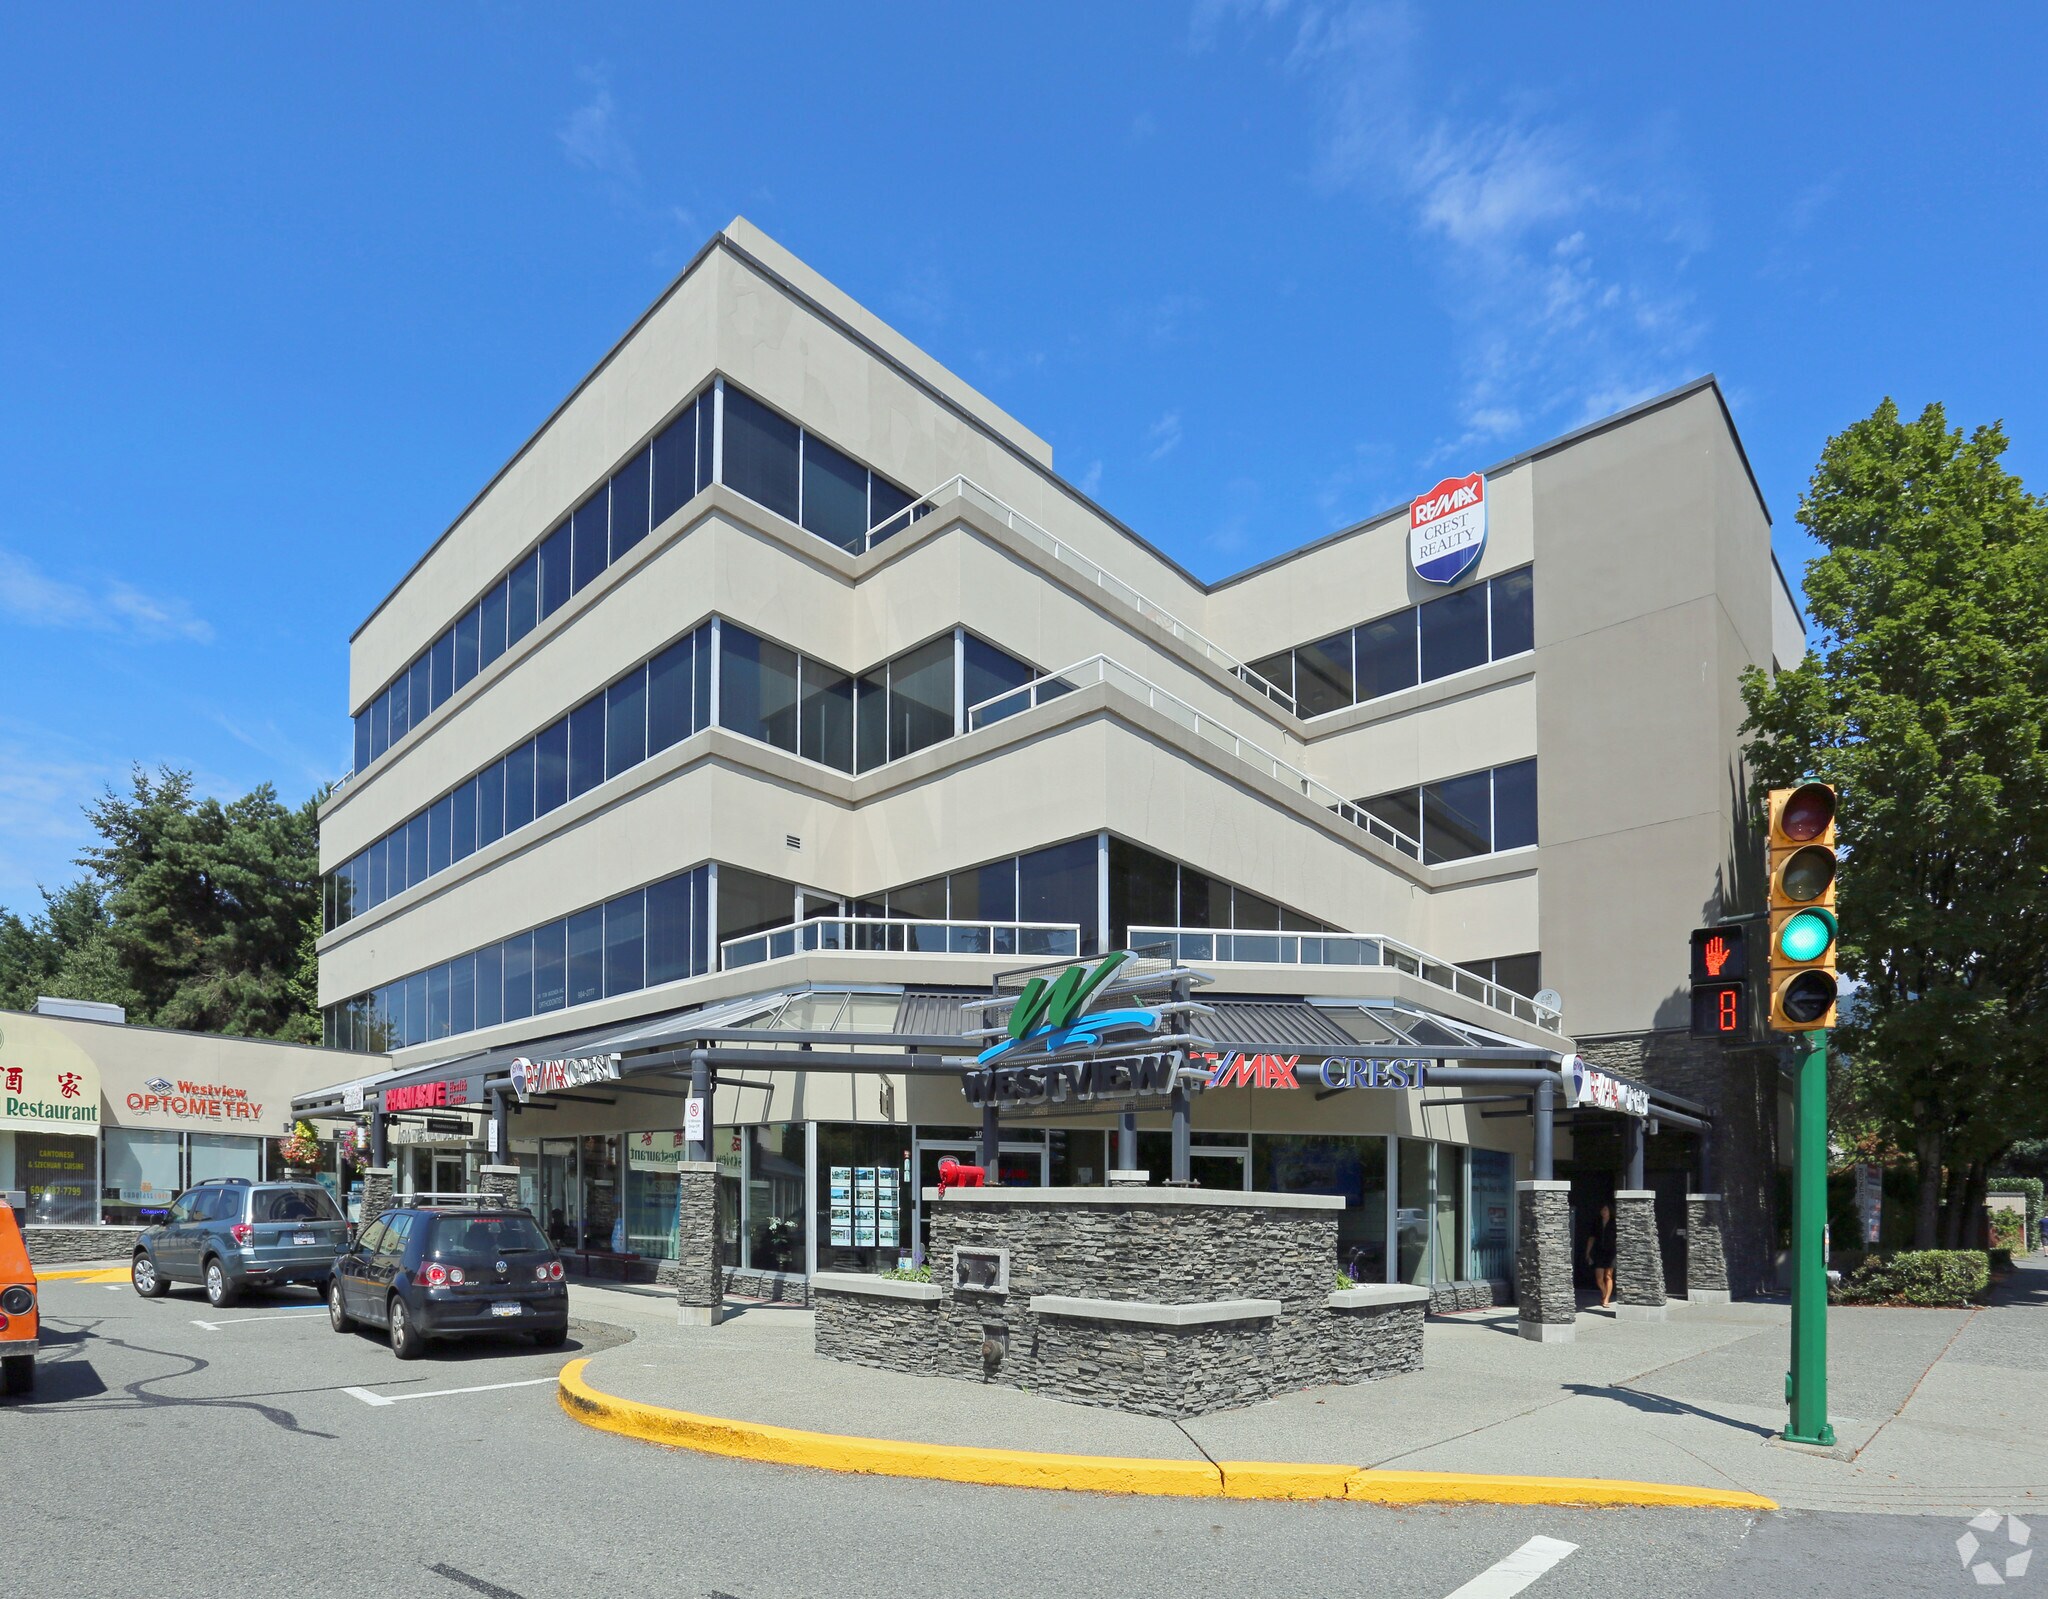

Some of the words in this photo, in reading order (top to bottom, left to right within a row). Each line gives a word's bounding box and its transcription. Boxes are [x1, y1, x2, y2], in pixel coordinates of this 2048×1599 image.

[1416, 482, 1479, 525] RE/MAX
[1424, 513, 1469, 541] CREST
[1419, 527, 1475, 559] REALTY
[1720, 991, 1736, 1031] 8
[449, 1079, 468, 1093] Health
[525, 1060, 570, 1094] RE/MAX
[567, 1053, 622, 1087] CREST
[961, 1053, 1180, 1107] WESTVIEW
[1320, 1055, 1431, 1090] CREST
[177, 1080, 247, 1099] Westview
[385, 1081, 447, 1112] PHARMASAVE
[448, 1094, 467, 1105] Centre
[6, 1097, 98, 1121] Restaurant
[126, 1092, 264, 1120] OPTOMETRY
[39, 1150, 75, 1158] CANTONESE
[64, 1162, 84, 1170] CUISINE
